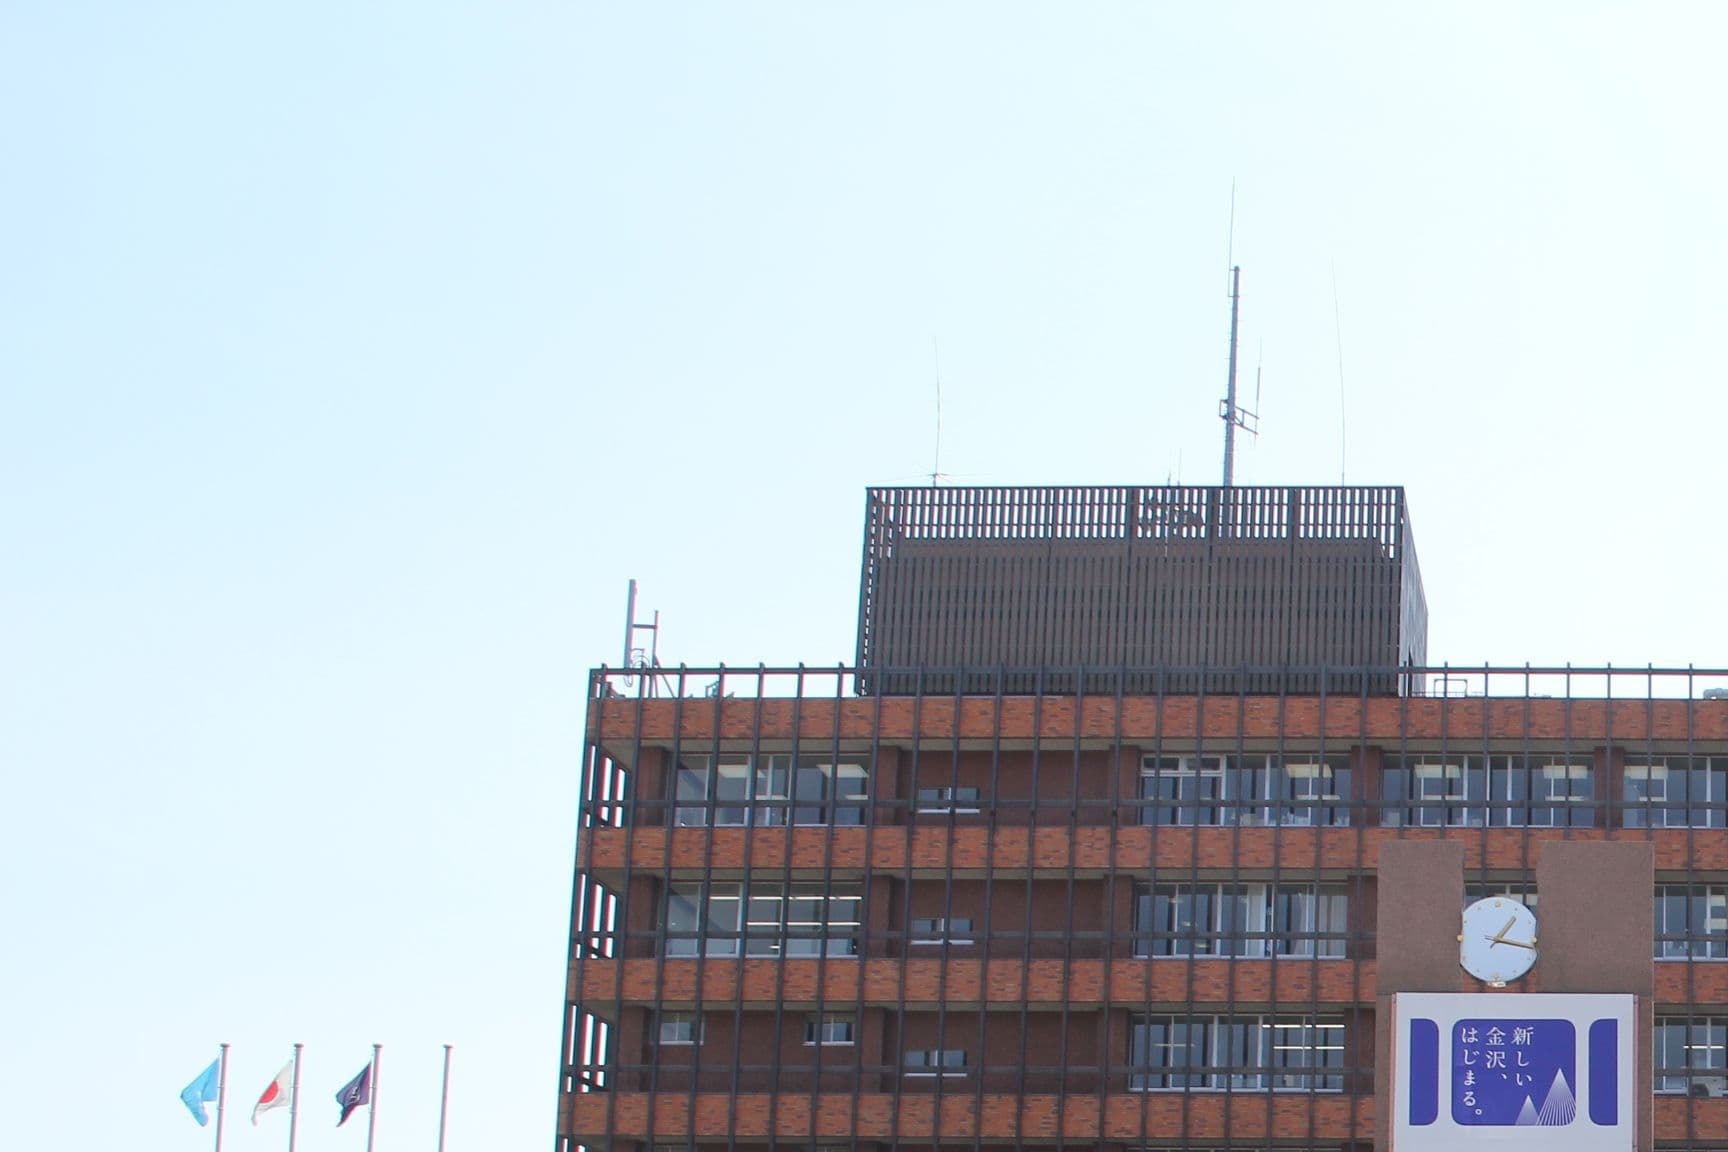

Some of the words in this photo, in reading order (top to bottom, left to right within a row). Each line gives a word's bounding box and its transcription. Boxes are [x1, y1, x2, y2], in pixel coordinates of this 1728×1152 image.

[1461, 1026, 1483, 1116] はじまる。
[1485, 1026, 1507, 1080] 金沢、
[1511, 1026, 1534, 1086] 新しい
